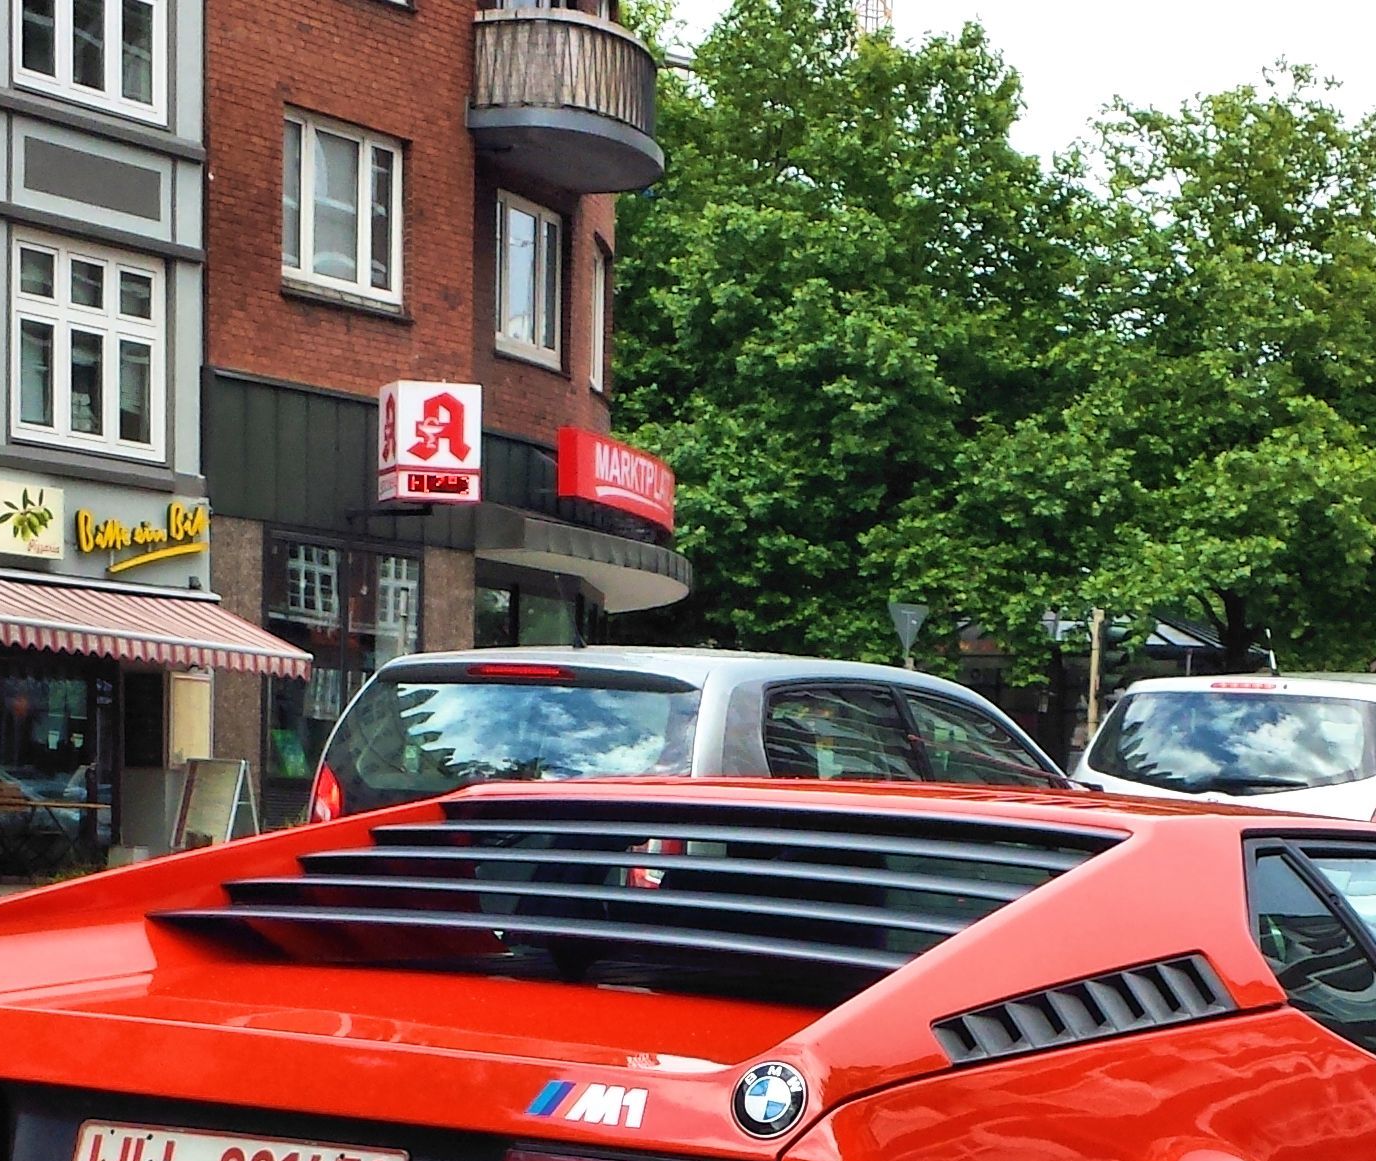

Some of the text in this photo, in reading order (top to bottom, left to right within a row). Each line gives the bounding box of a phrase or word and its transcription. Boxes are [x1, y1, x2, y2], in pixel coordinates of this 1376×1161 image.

[77, 508, 132, 553] Bitte
[131, 521, 167, 544] ein
[744, 1065, 804, 1093] BMW
[565, 1083, 649, 1129] M1
